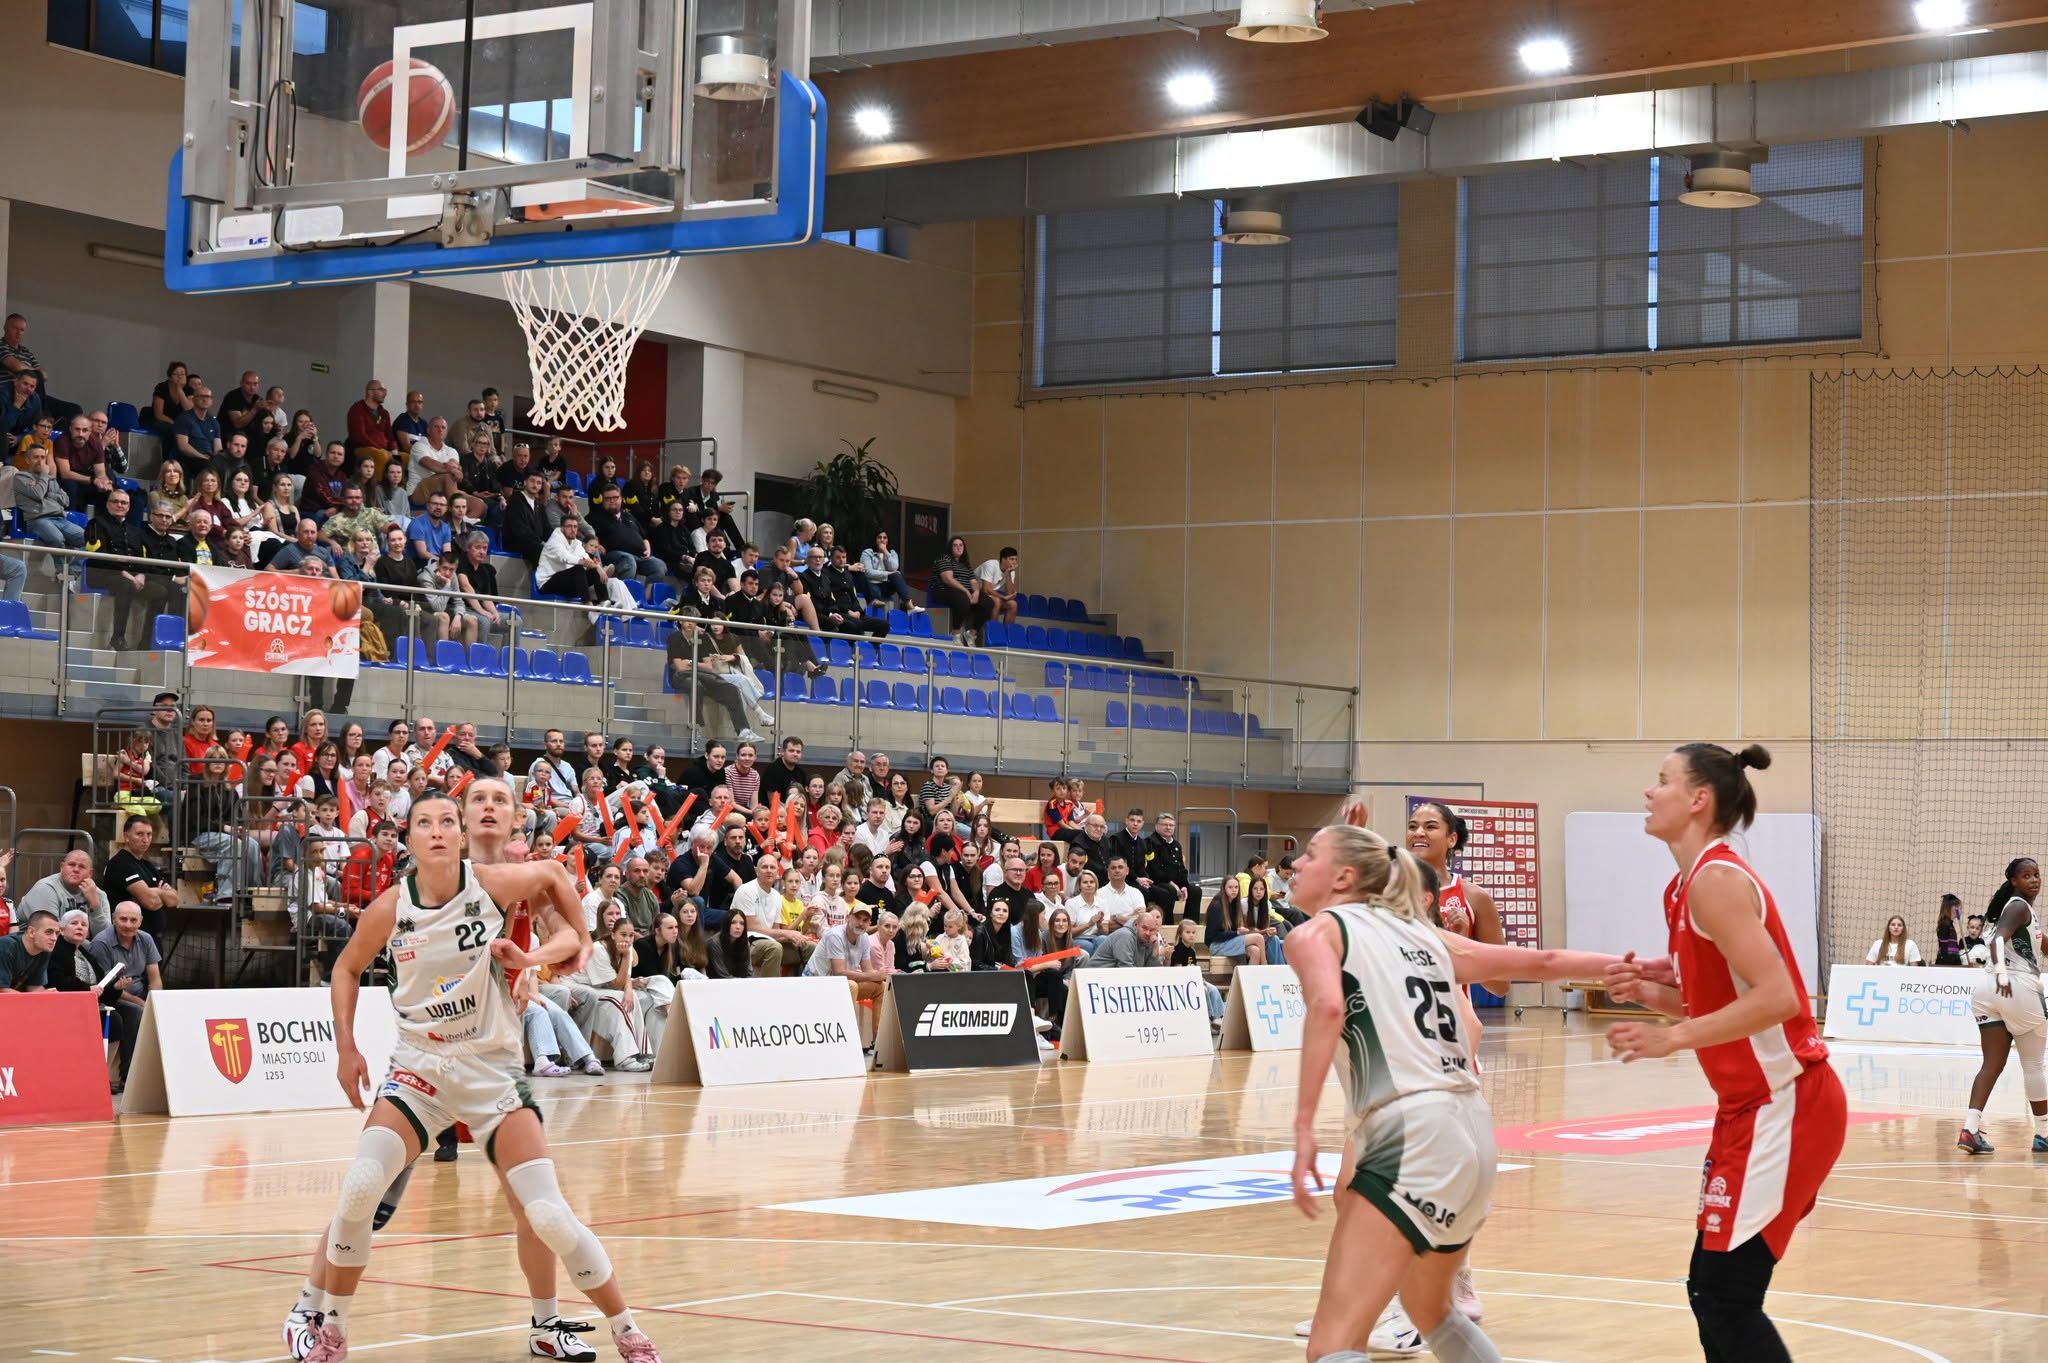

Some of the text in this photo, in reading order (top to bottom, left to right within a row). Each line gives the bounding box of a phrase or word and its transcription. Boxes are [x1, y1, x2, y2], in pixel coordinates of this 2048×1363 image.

[244, 610, 312, 636] GRACZ
[455, 920, 487, 952] 22
[425, 994, 476, 1018] LUBLIN
[1088, 981, 1200, 1014] FISHERKING
[1405, 976, 1458, 1042] 25
[941, 1010, 1009, 1028] EKOMBUD
[732, 1022, 847, 1048] MAŁOPOLSKA
[262, 1051, 326, 1065] MIASTO SOLI
[265, 1071, 285, 1080] 1253
